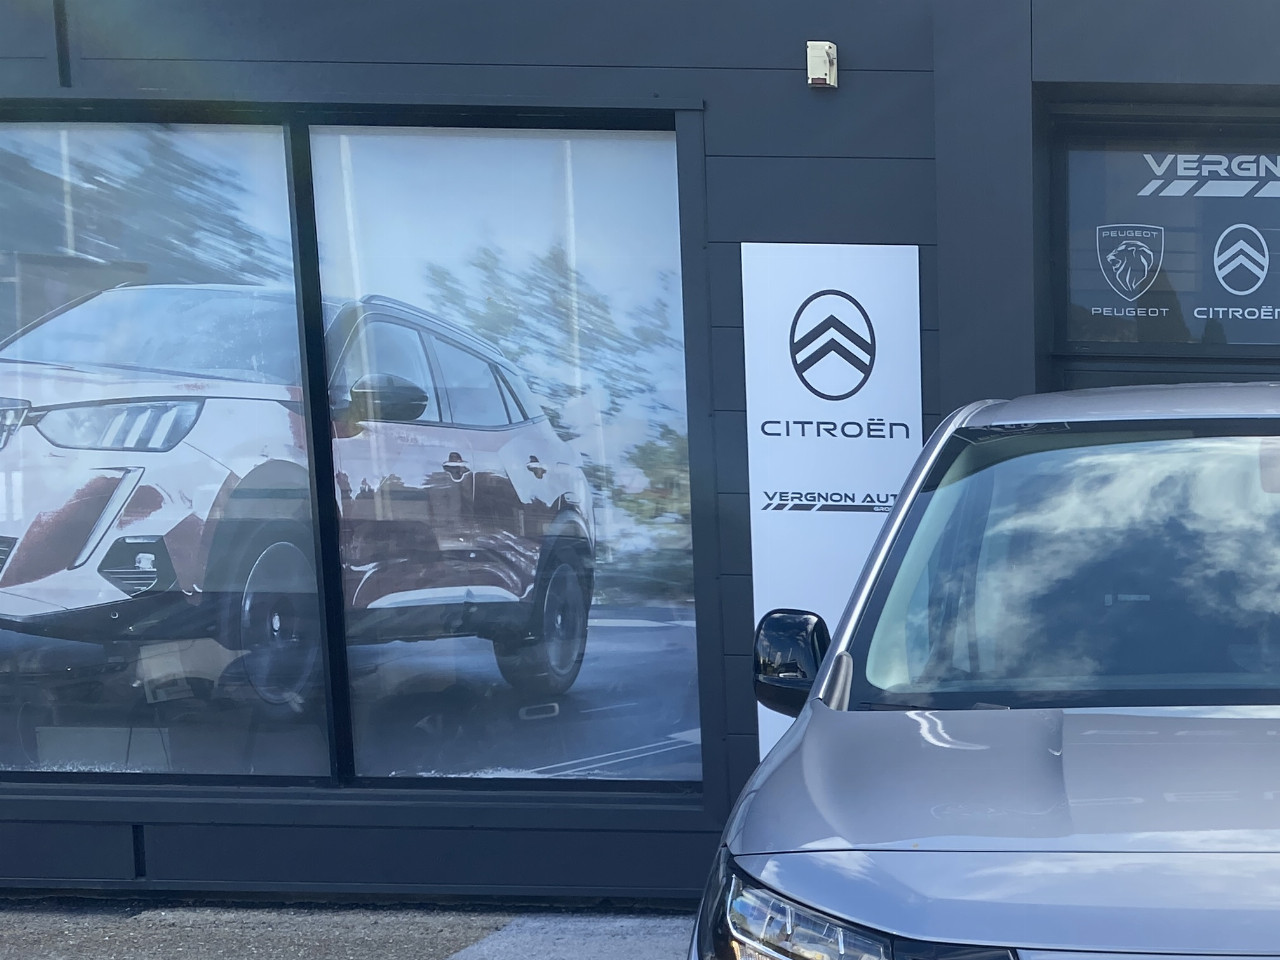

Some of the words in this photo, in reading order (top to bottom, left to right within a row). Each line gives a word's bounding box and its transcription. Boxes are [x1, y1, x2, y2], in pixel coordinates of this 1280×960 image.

[1102, 230, 1159, 239] PEUGEOT
[1091, 307, 1170, 317] PEUGEOT
[763, 491, 856, 503] VERGNON
[861, 494, 898, 504] AUT
